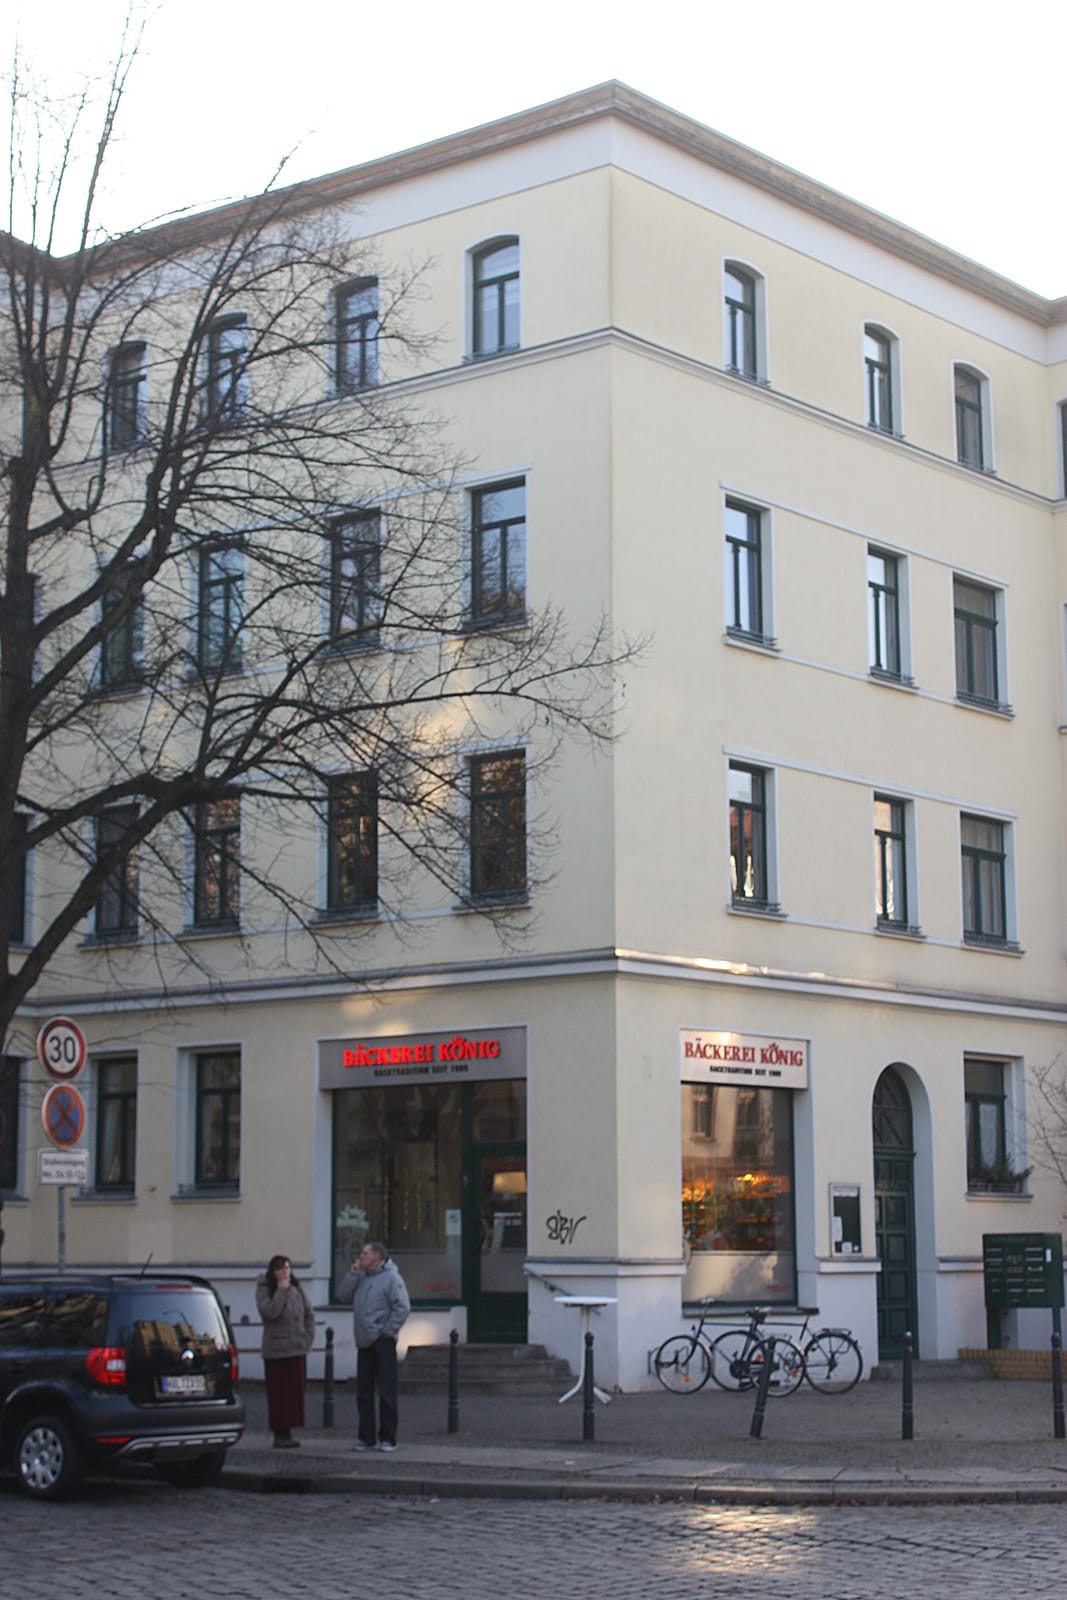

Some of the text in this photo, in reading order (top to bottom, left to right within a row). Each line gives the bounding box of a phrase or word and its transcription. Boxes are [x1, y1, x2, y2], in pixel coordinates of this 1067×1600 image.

[49, 1036, 75, 1063] 30
[343, 1036, 500, 1067] BÄCKEREI KÖNIG
[684, 1038, 804, 1067] BÄCKEREI KÖNIG
